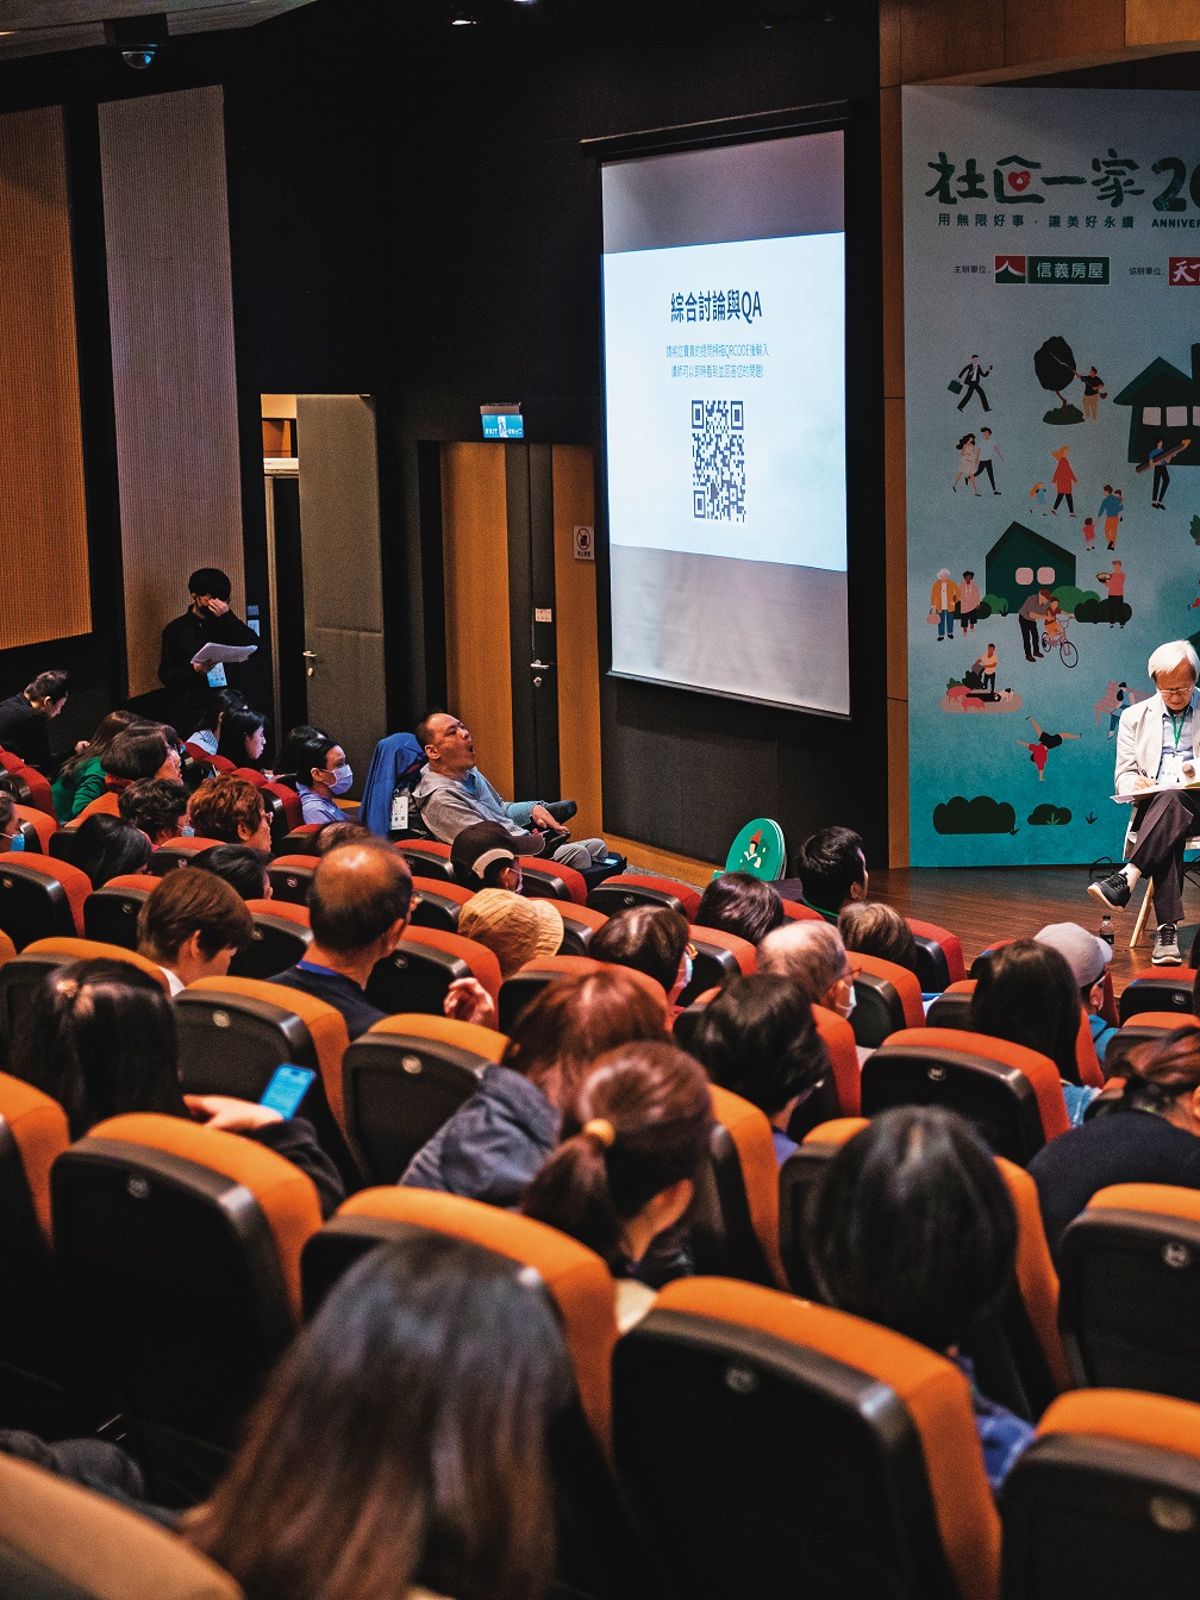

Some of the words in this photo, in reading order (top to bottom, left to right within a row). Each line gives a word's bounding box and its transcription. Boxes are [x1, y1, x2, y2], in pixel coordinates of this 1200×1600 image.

[1036, 262, 1104, 279] 信義房屋
[671, 288, 763, 325] 綜合討論與QA
